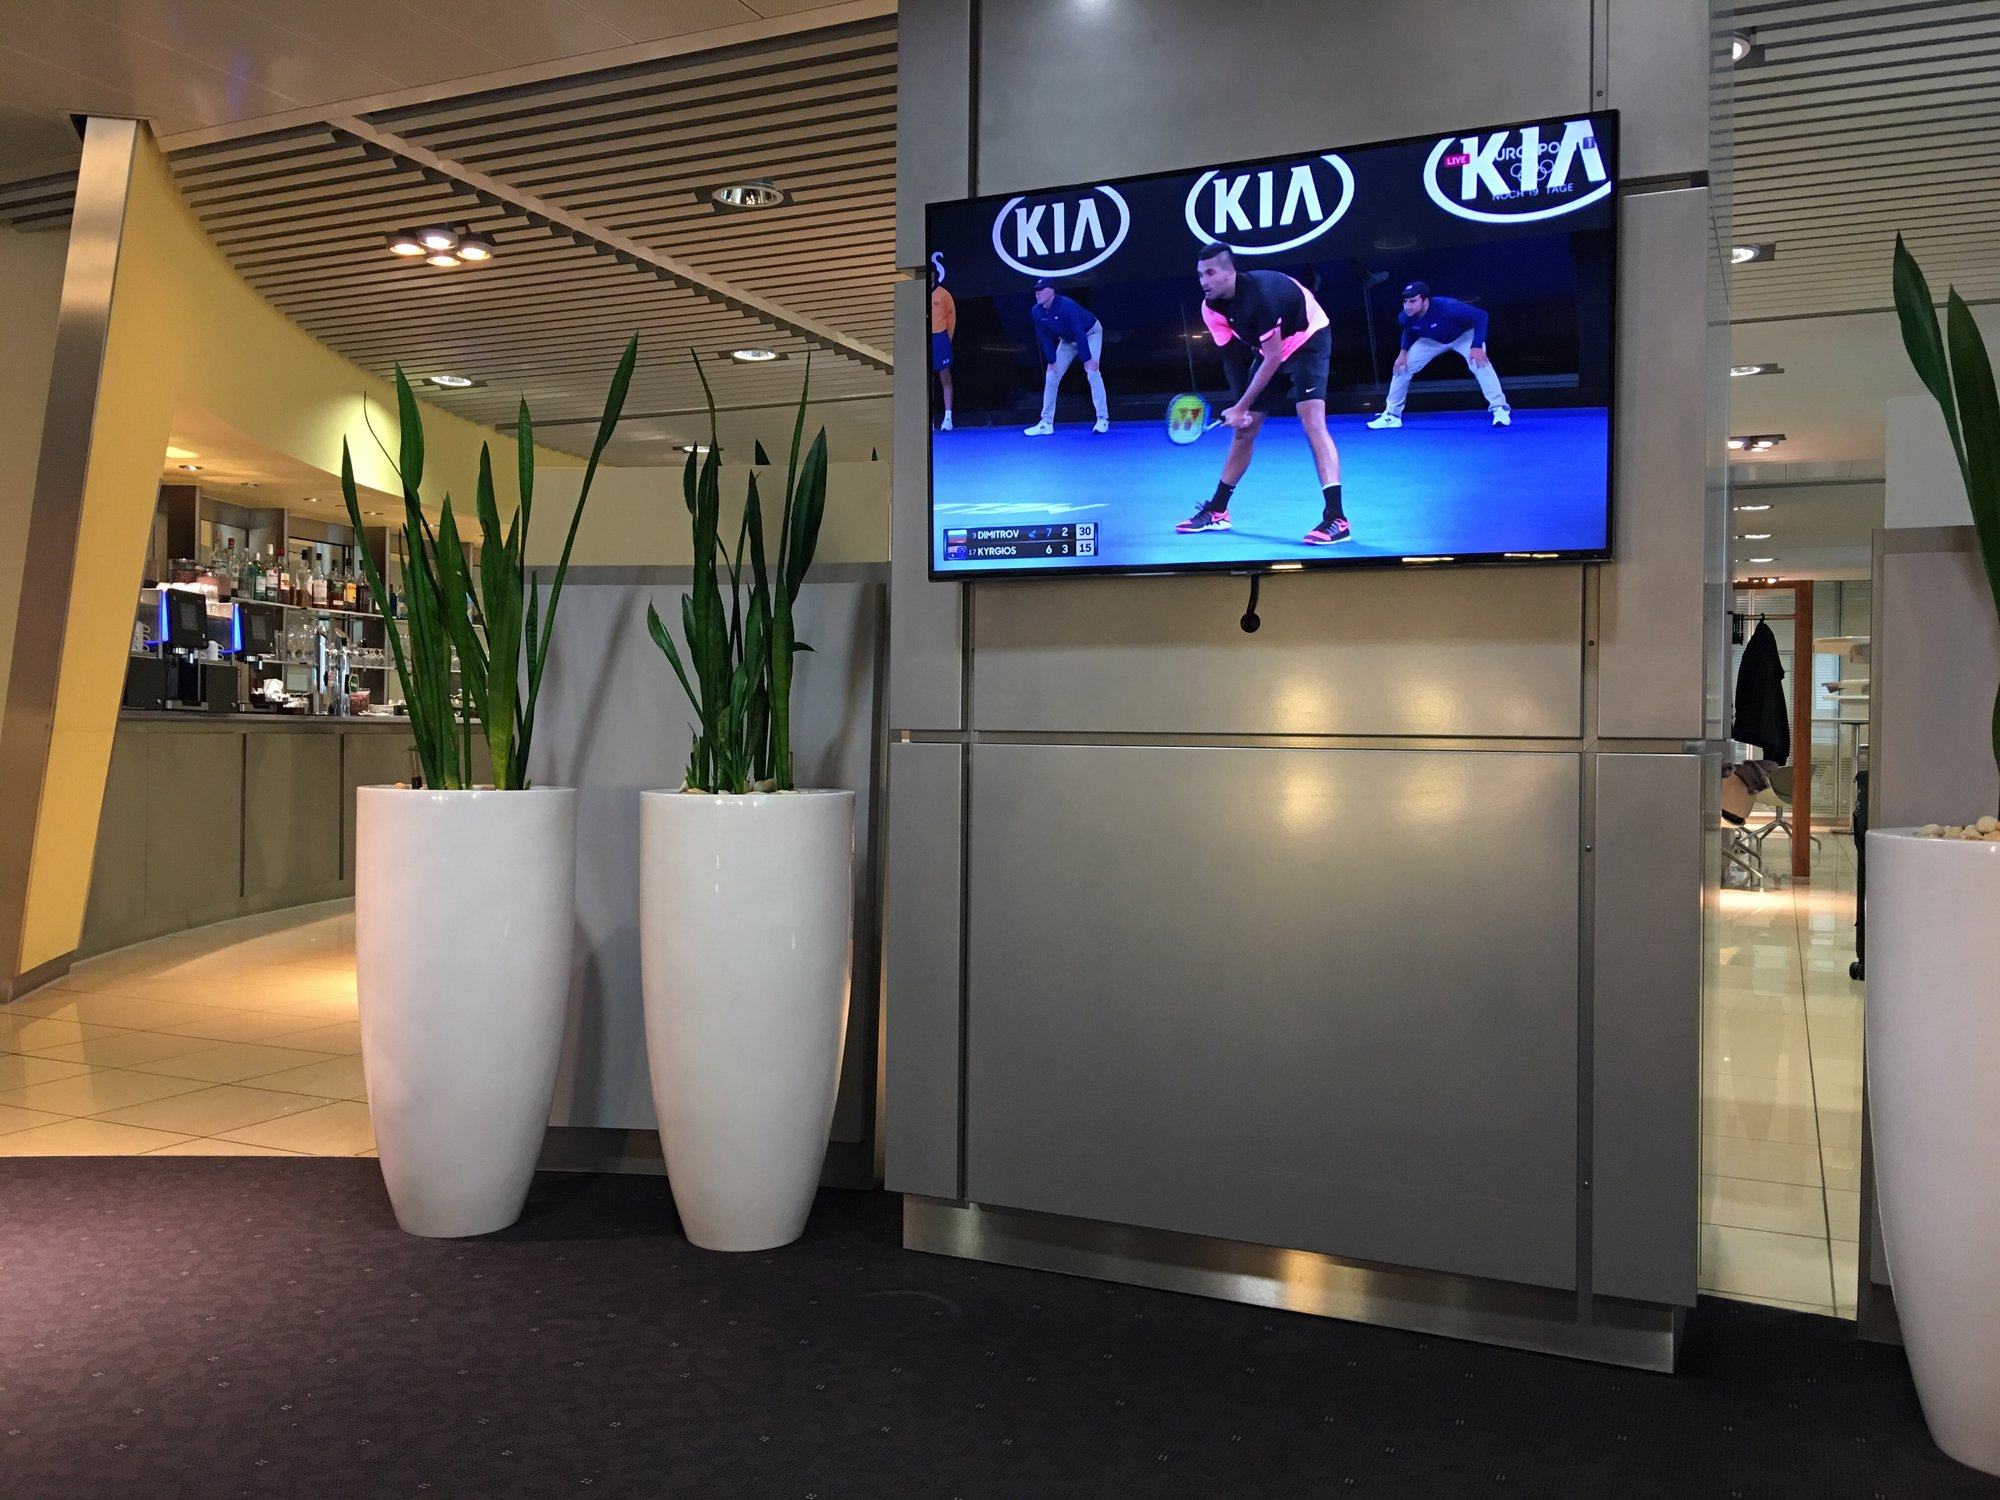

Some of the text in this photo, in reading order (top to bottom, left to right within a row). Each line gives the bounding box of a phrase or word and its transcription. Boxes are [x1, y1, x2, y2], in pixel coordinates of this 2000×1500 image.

[1446, 155, 1466, 165] LIVE
[1459, 119, 1607, 201] KIA
[1213, 165, 1324, 234] KIA
[1492, 189, 1524, 201] NOCH
[1546, 182, 1575, 194] TAGE
[1015, 198, 1106, 258] KIA
[977, 529, 1020, 540] DIMITROV
[1046, 528, 1053, 538] 7
[1061, 527, 1069, 537] 2
[1078, 526, 1092, 536] 30
[968, 543, 1092, 556] 17 KYRGIOS 6 3 15
